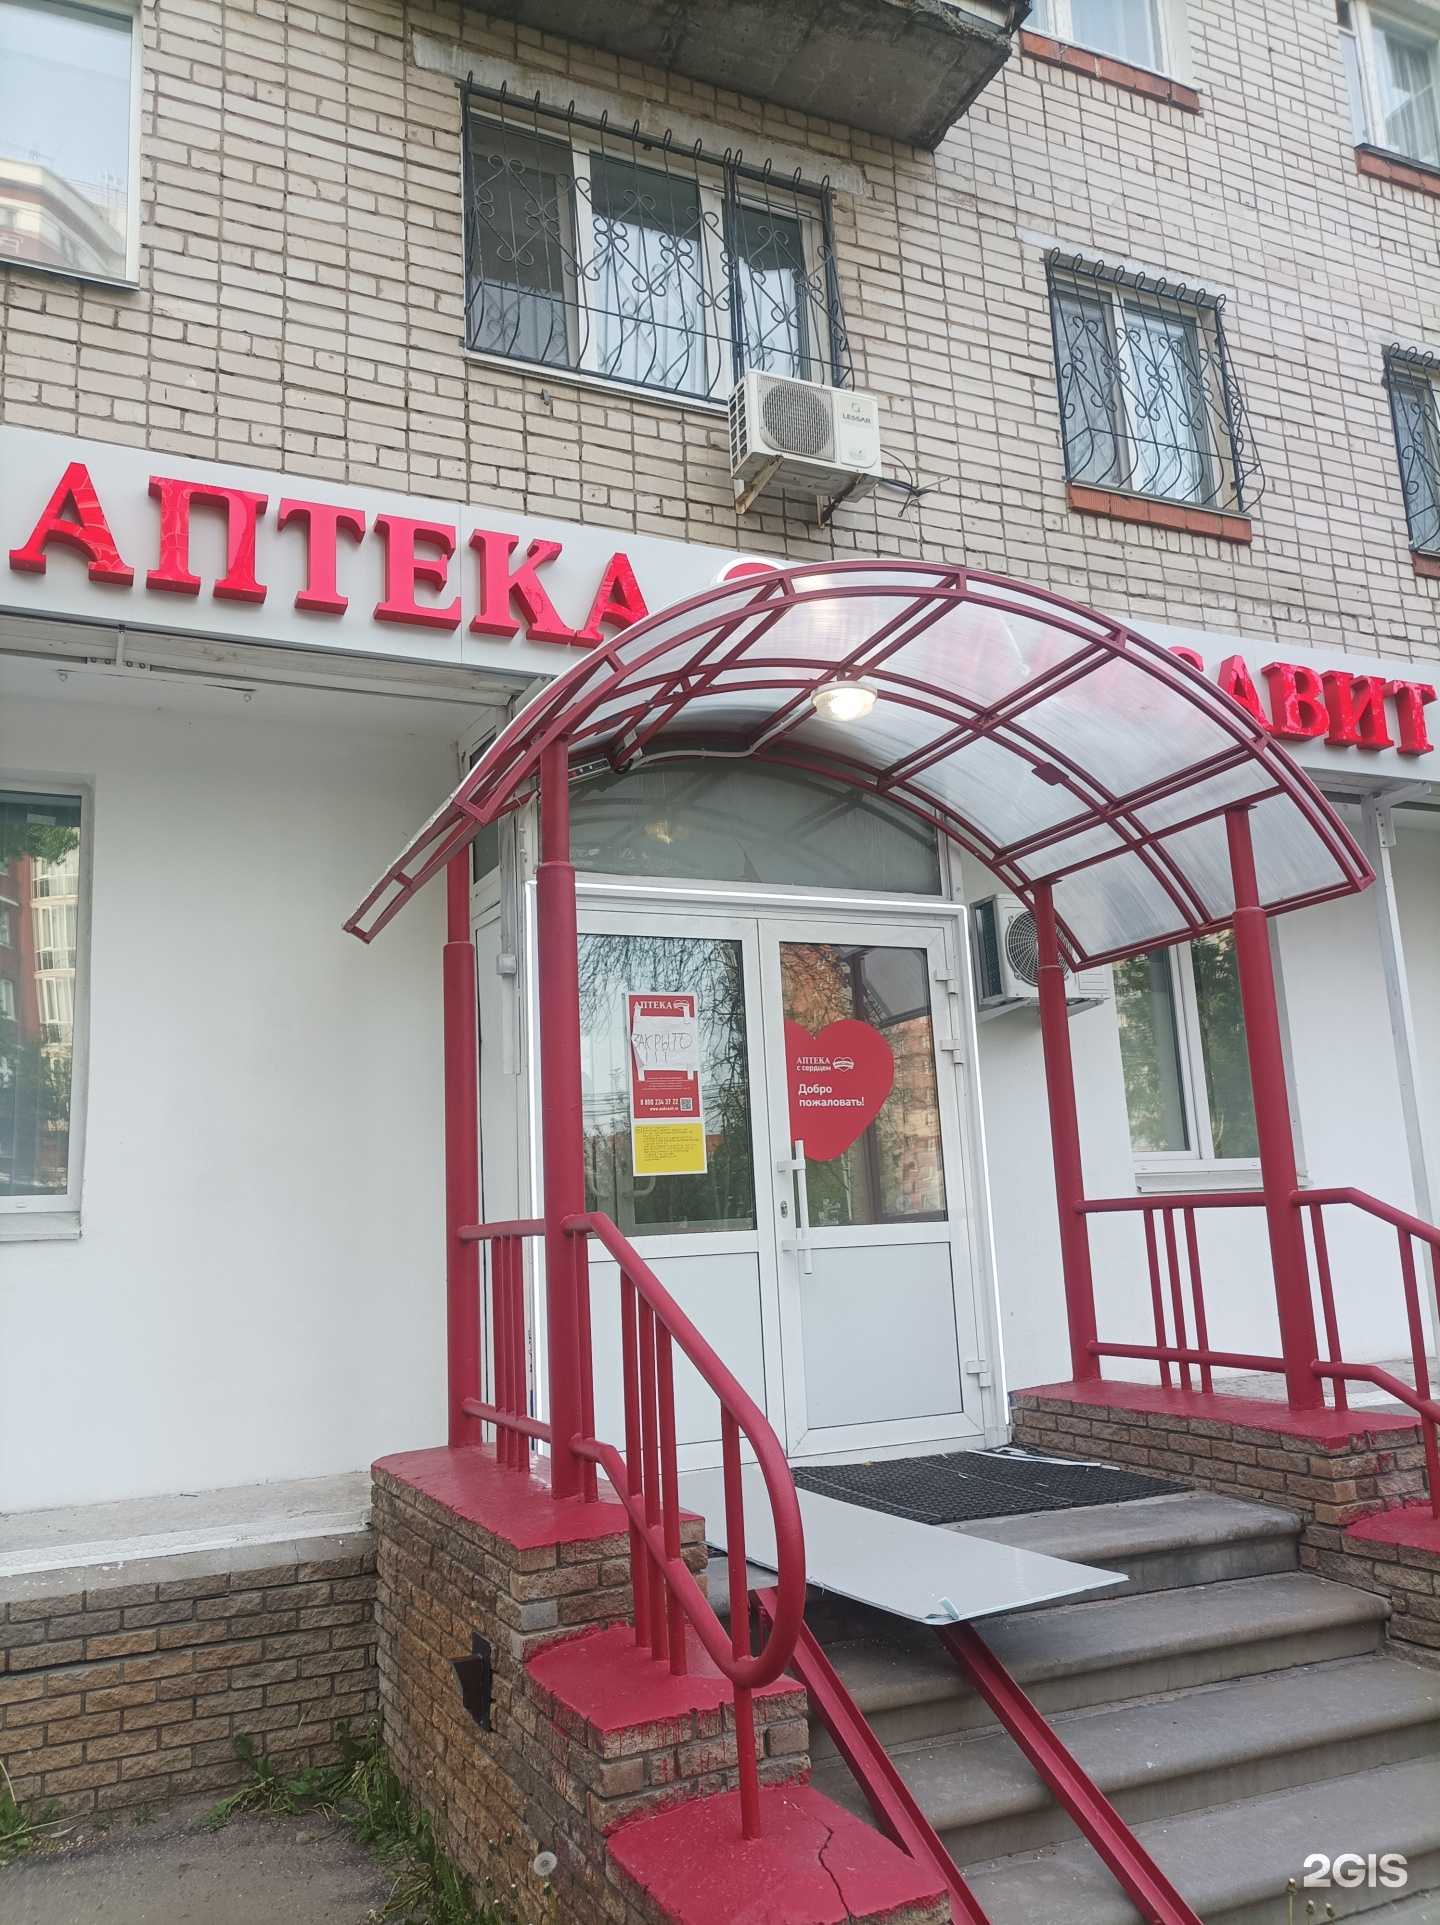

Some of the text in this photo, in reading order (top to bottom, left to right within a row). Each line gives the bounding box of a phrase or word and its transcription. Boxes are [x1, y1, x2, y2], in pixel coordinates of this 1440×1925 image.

[842, 413, 871, 424] LESSAR
[9, 461, 649, 648] АПТЕКА
[1168, 646, 1438, 756] АВИТ
[632, 1032, 693, 1050] ЗАКРЫТО
[796, 1056, 831, 1065] АПТЕКА
[802, 1065, 832, 1073] сердцем
[798, 1083, 833, 1096] Добро
[799, 1096, 865, 1107] пожаловать!
